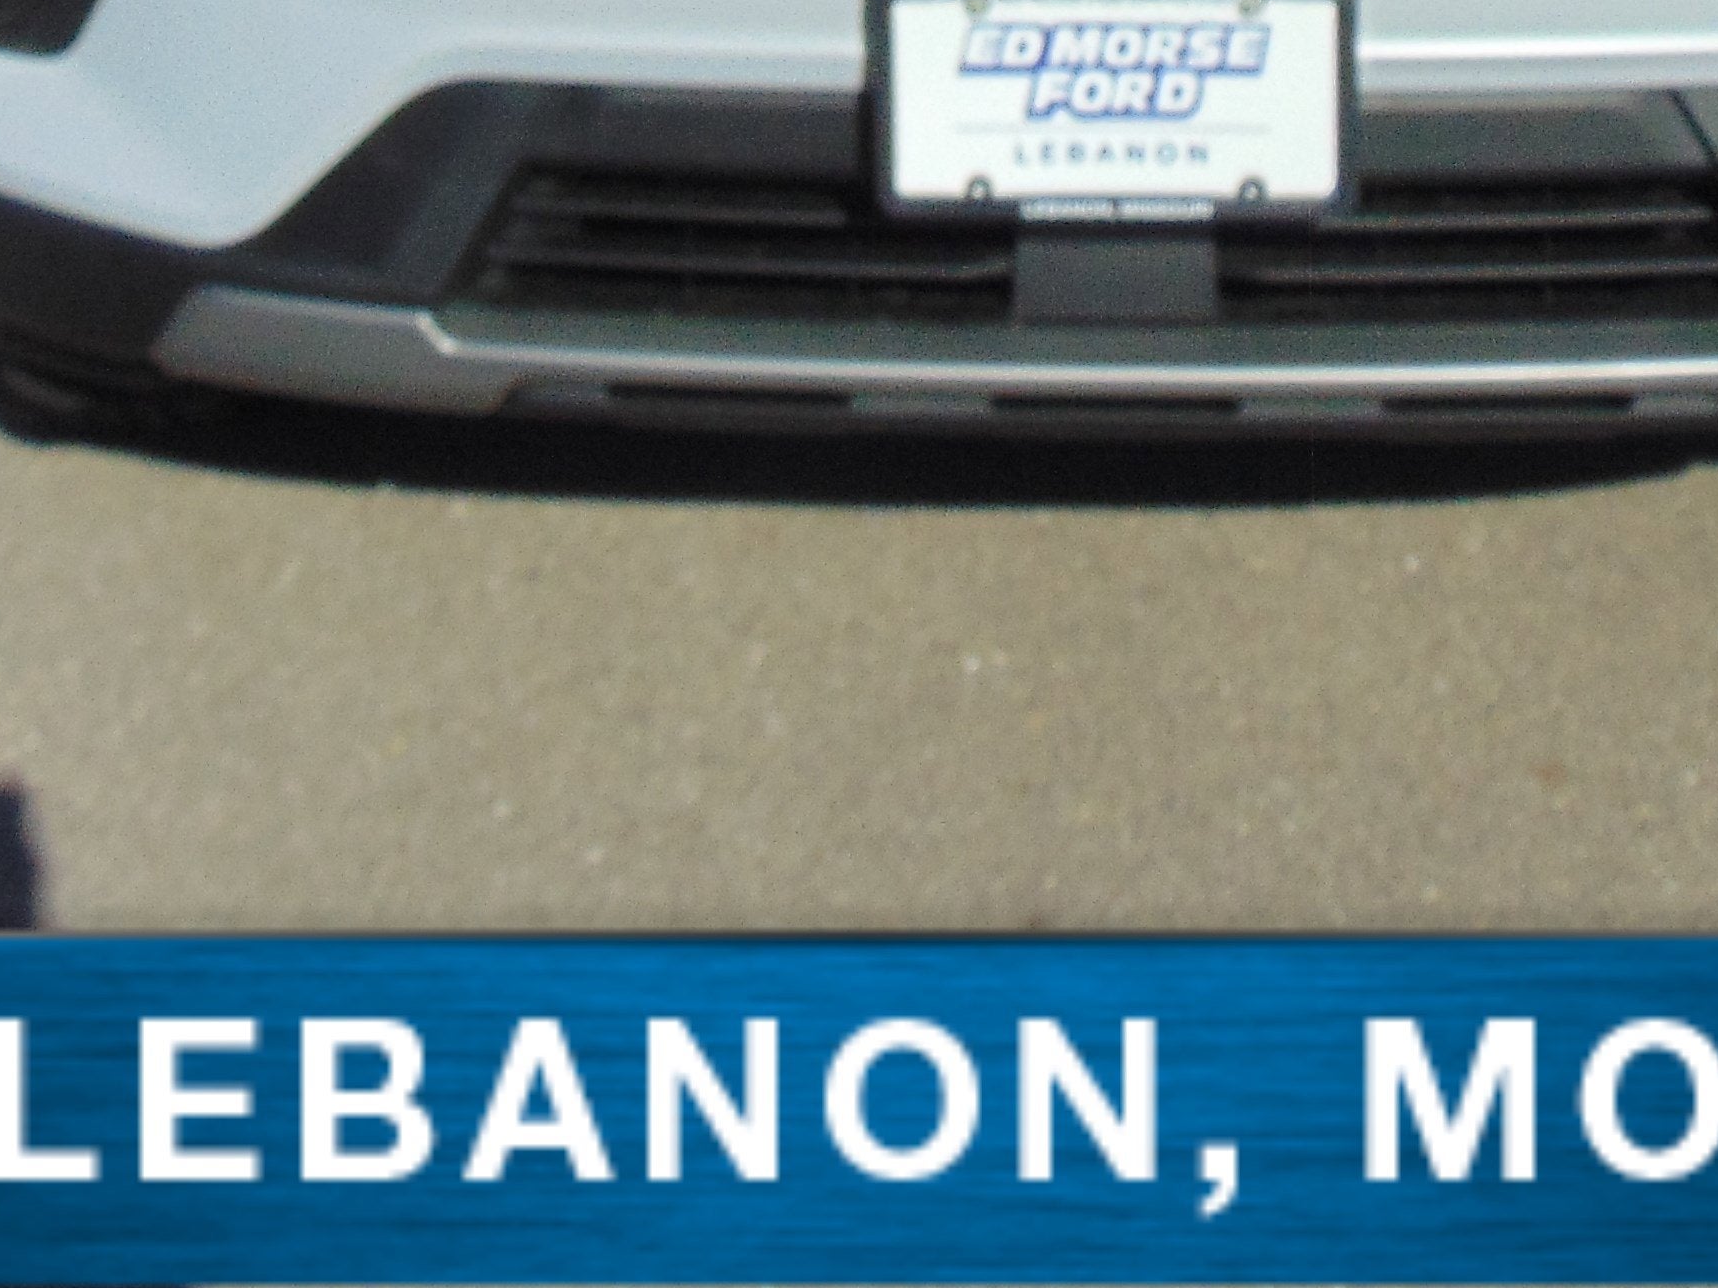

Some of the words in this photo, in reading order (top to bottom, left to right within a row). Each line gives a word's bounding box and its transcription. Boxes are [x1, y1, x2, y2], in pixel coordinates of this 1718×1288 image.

[959, 24, 1046, 75] ED
[1045, 24, 1271, 75] MORSE
[1026, 69, 1206, 121] FORD
[1013, 142, 1209, 166] LEBANON
